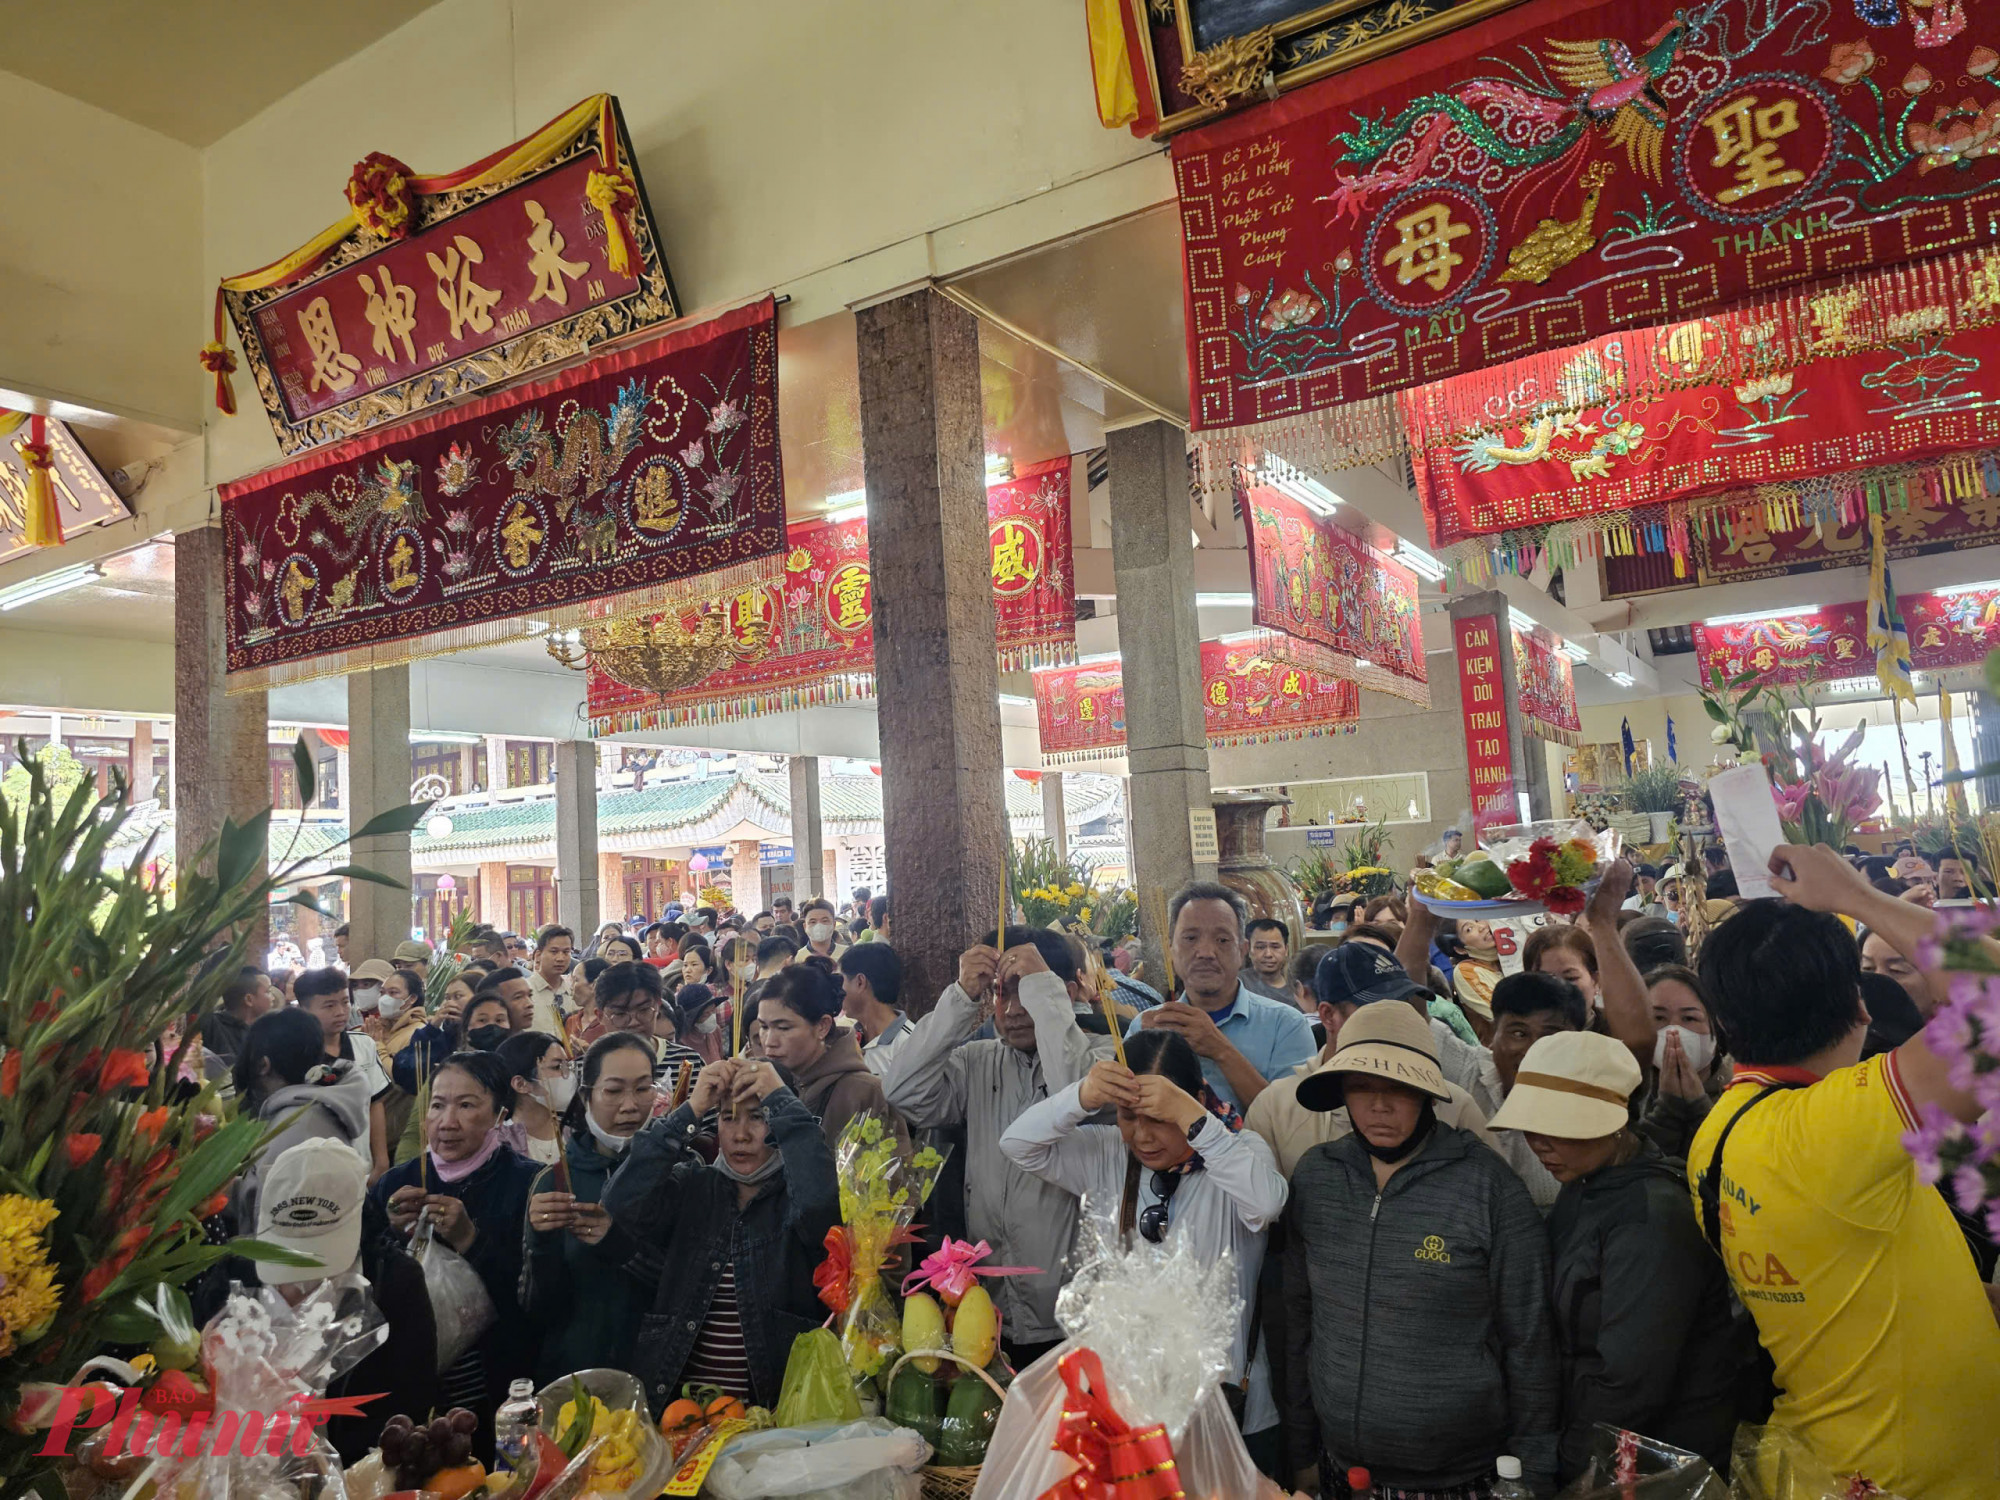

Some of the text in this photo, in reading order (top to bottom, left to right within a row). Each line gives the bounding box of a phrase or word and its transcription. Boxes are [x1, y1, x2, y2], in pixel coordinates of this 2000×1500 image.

[1382, 95, 1805, 291] 母 聖
[1243, 246, 1286, 268] Cúng
[1469, 710, 1501, 730] TRAU
[1476, 738, 1500, 760] TẠO
[1475, 766, 1507, 787] HẠNH
[1493, 927, 1517, 956] 6
[291, 1196, 316, 1207] NEW
[317, 1197, 341, 1215] YORK
